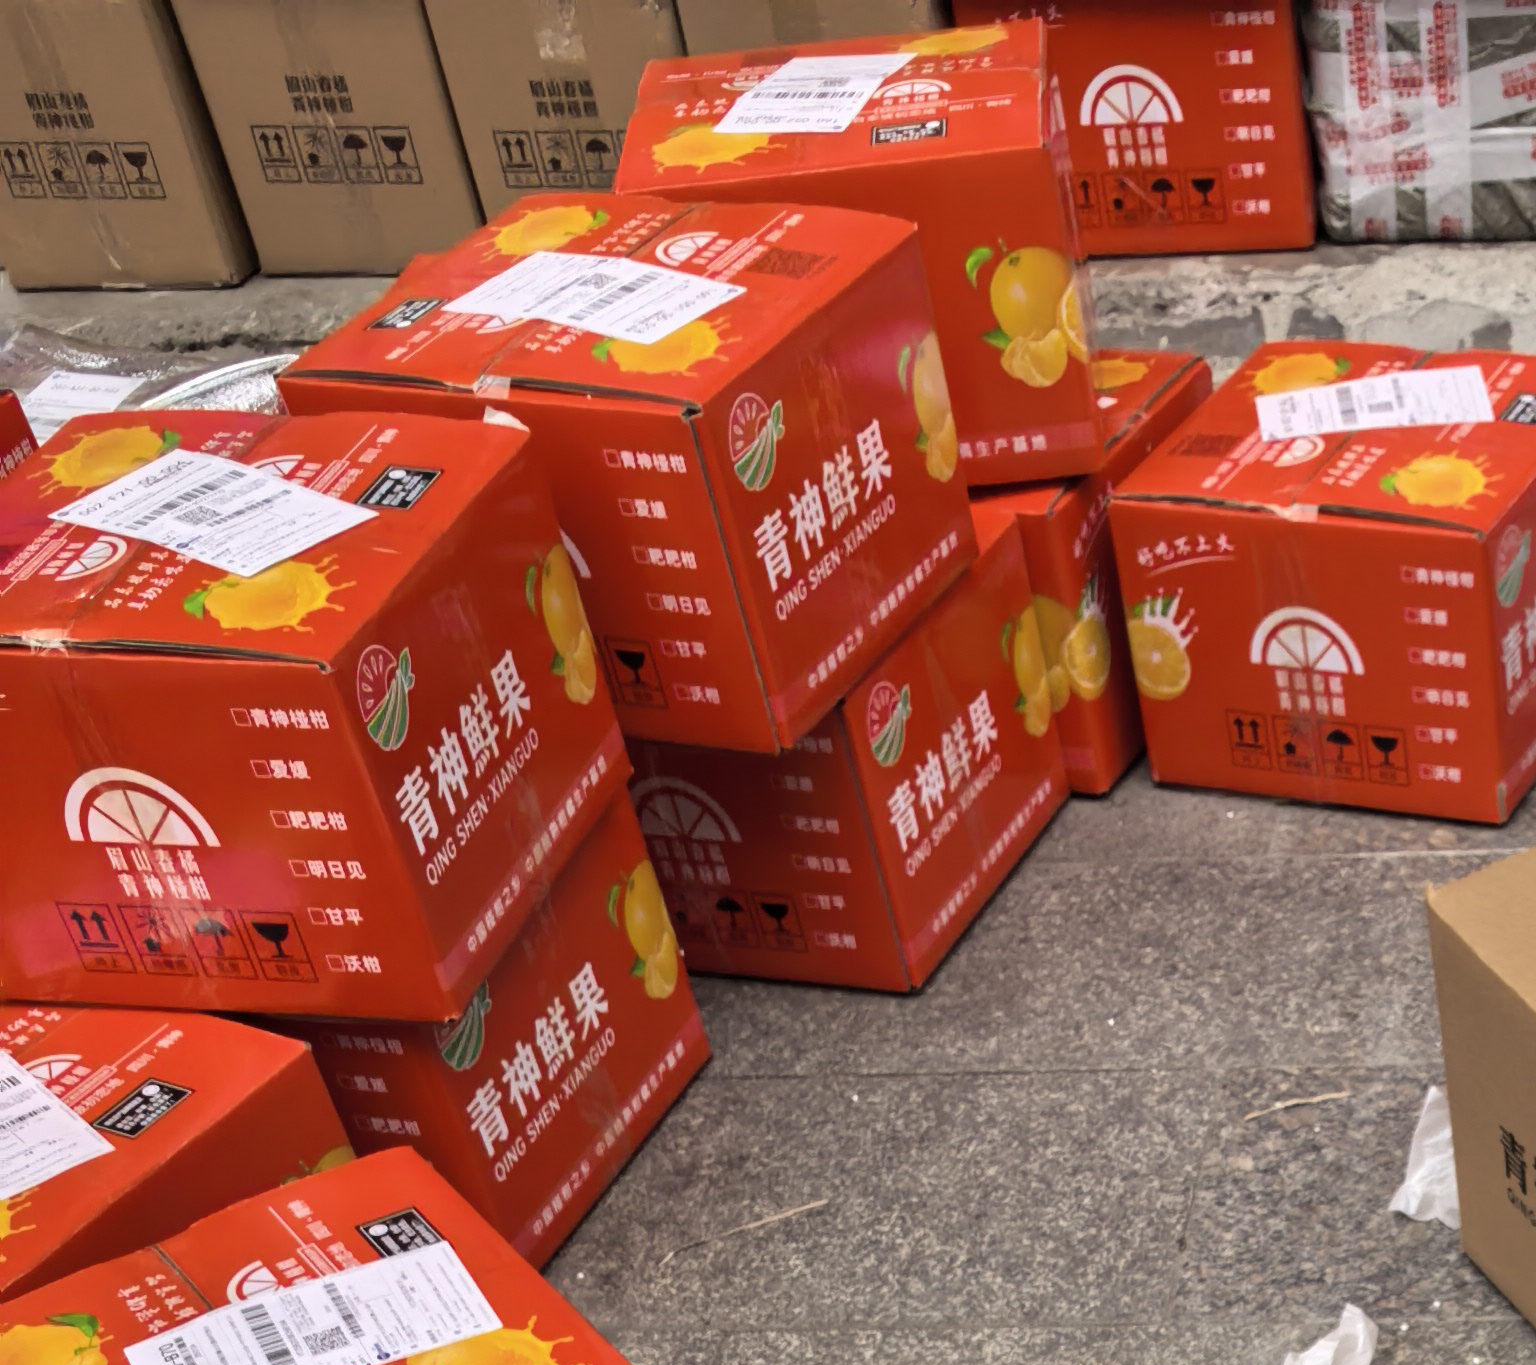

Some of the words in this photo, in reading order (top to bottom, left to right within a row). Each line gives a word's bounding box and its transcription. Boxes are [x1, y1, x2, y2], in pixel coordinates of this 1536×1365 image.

[250, 707, 331, 731] 青神椪柑
[270, 758, 312, 782] 爱媛
[289, 808, 349, 833] 粑粑柑
[307, 858, 368, 881] 明日见
[425, 836, 458, 887] QING
[325, 905, 364, 927] 甘平
[345, 953, 383, 975] 沃柑
[493, 1136, 526, 1182] QING
